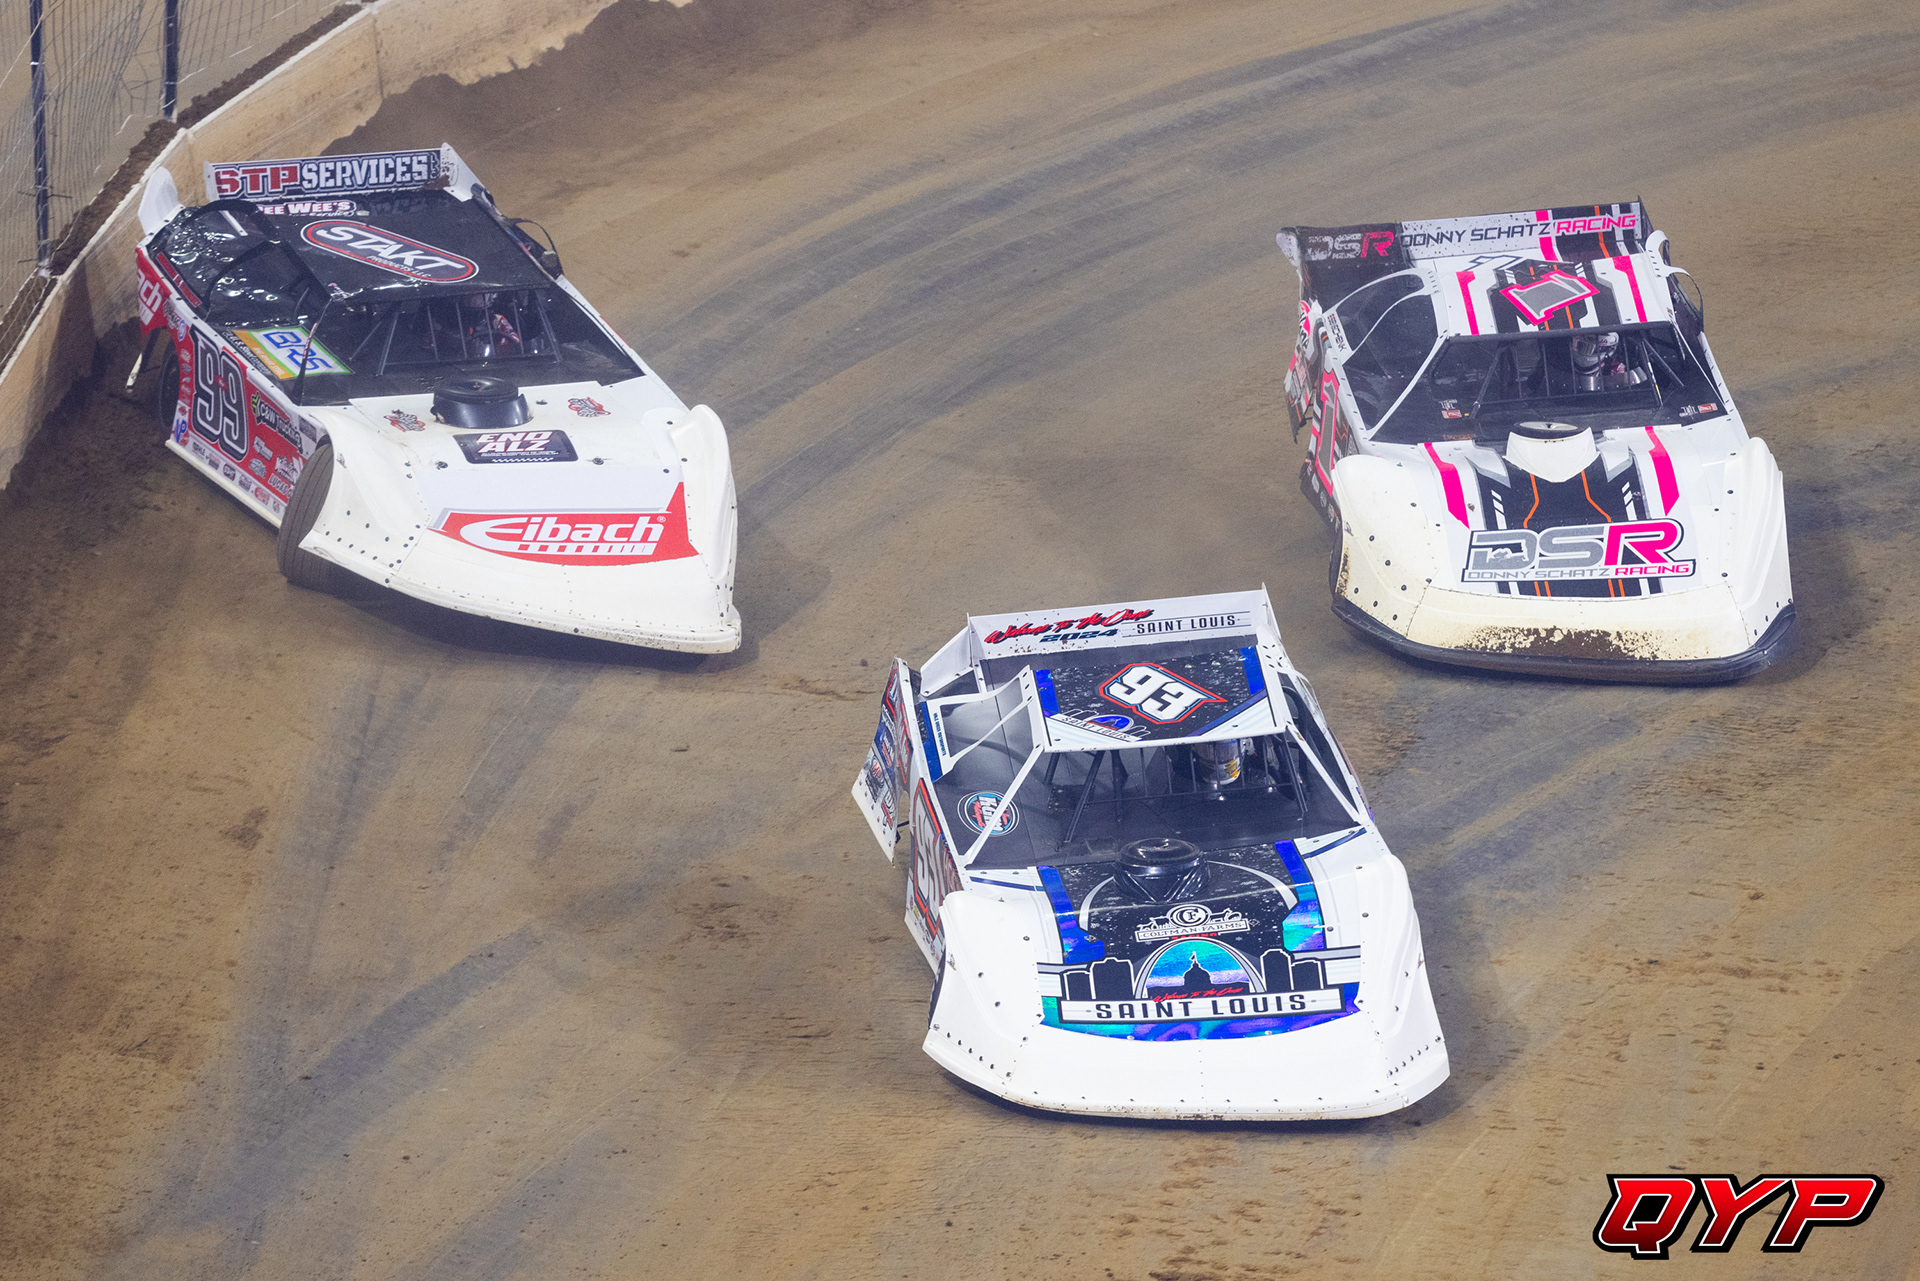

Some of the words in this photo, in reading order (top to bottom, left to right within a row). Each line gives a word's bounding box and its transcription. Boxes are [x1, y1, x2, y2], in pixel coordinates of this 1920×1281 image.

[214, 164, 299, 194] STP
[301, 155, 429, 190] SERVICES
[257, 205, 285, 215] EE
[1305, 230, 1395, 262] DSR
[1401, 229, 1467, 249] DONNY
[1470, 221, 1553, 242] SCHATZ
[1555, 214, 1637, 235] RACING
[315, 226, 466, 273] STAKT
[195, 330, 250, 457] 99
[476, 431, 553, 443] END
[477, 439, 551, 453] ALZ
[459, 516, 665, 554] Eibach
[1471, 521, 1679, 571] DSR
[1467, 570, 1531, 580] DONNY
[1534, 567, 1611, 579] SCHATZ
[1614, 563, 1690, 577] RACING
[1039, 628, 1119, 643] 2024
[1136, 619, 1184, 634] SAINT
[1190, 614, 1236, 630] LOUIS
[1108, 665, 1200, 723] 93
[1096, 1000, 1193, 1019] SAINT
[1211, 994, 1307, 1016] LOUIS
